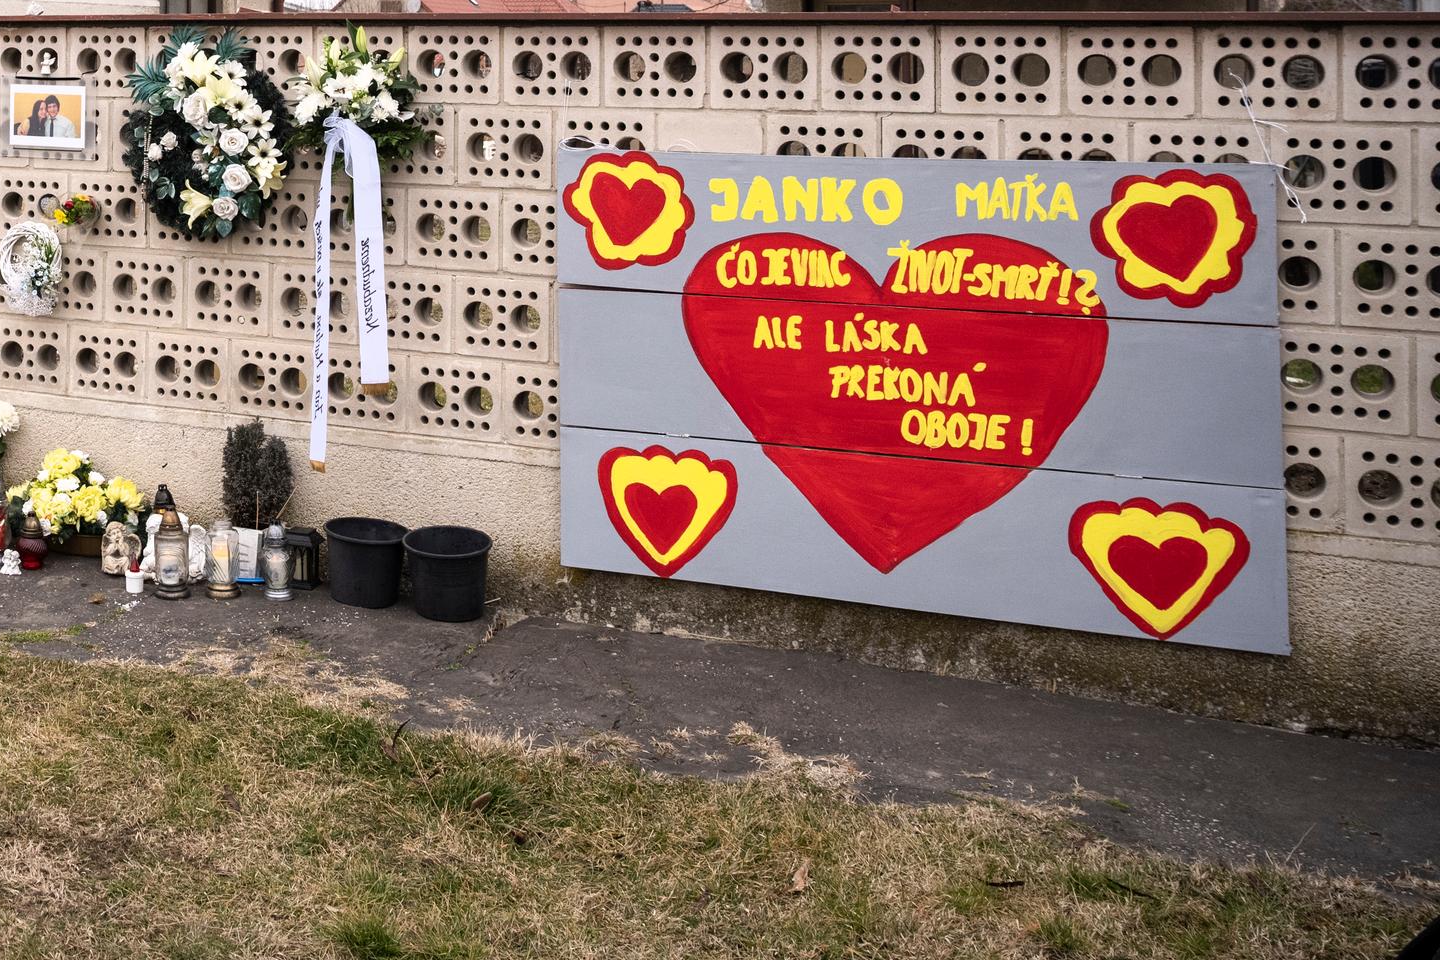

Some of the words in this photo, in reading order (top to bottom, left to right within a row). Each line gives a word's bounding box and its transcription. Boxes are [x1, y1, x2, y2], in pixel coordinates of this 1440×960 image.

[708, 176, 904, 226] JANKO
[753, 315, 803, 350] ALE
[825, 312, 929, 355] LÁSKA
[829, 361, 987, 407] PREKONÁ
